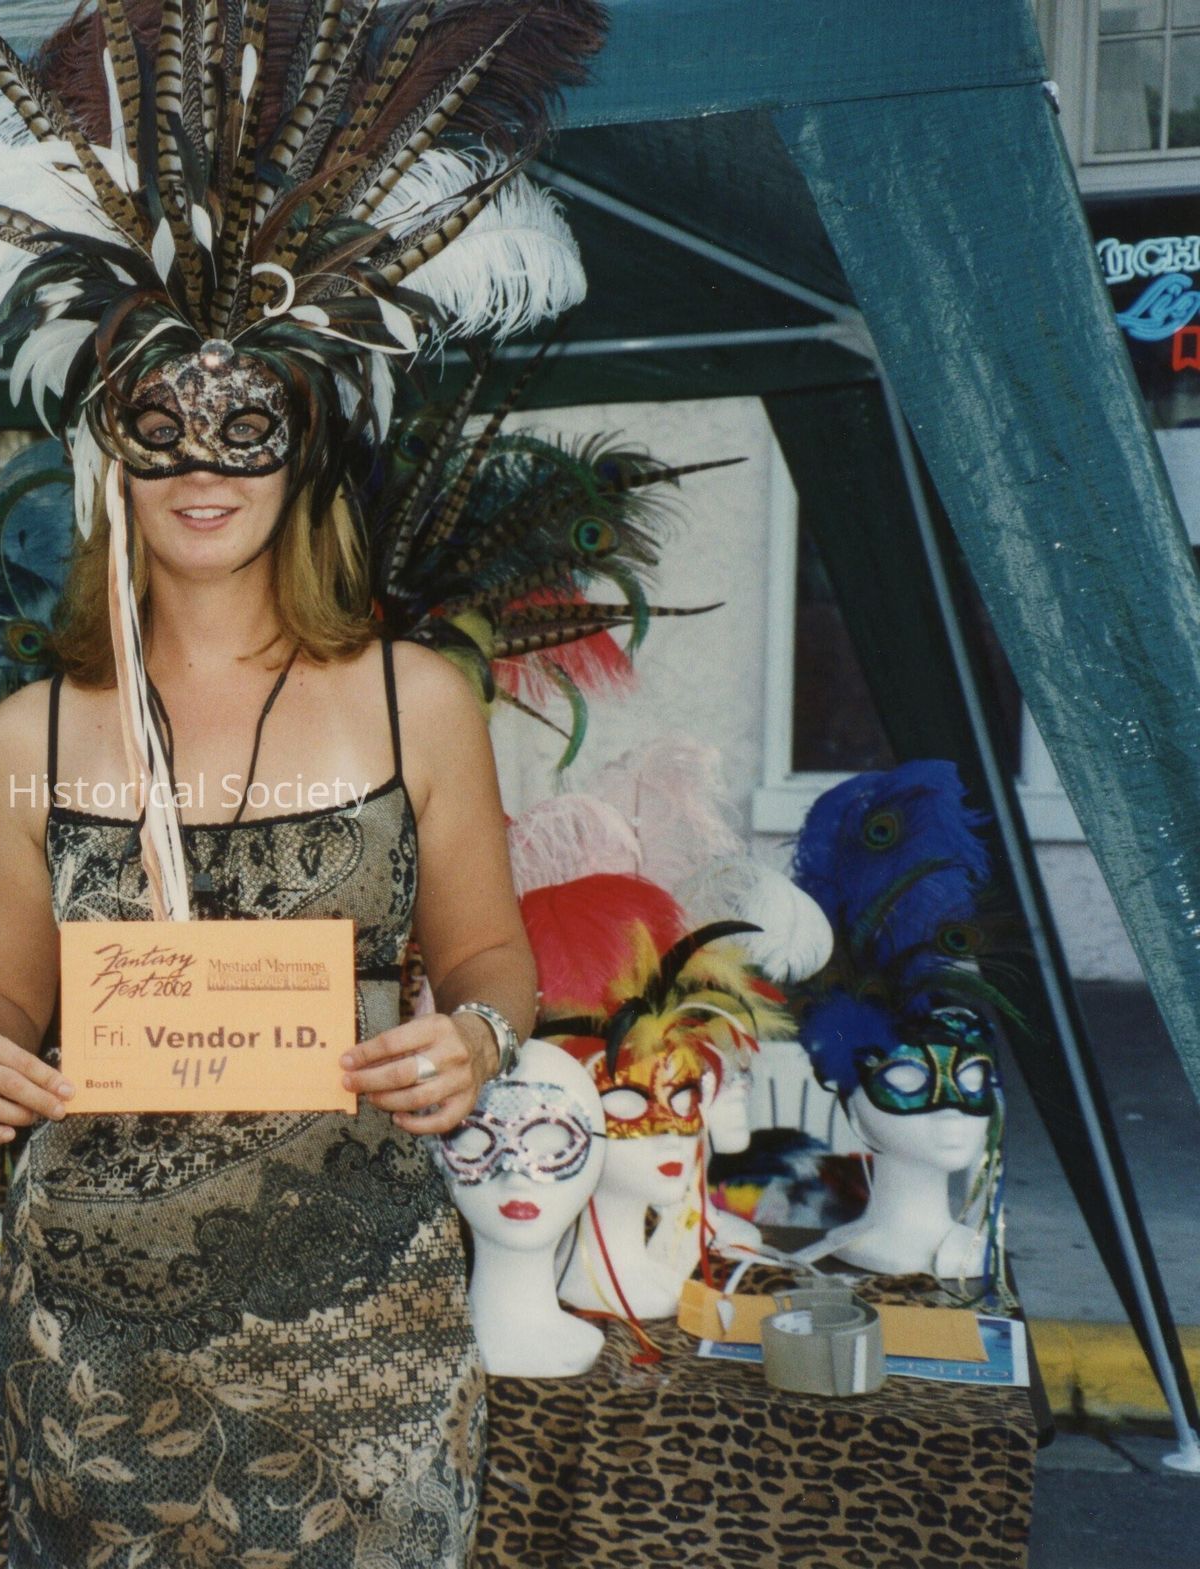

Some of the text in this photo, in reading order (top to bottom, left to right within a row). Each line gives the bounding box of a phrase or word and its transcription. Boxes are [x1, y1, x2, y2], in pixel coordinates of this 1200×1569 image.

[94, 944, 197, 972] Fantasy
[208, 958, 328, 975] Mystical Mornings
[90, 969, 193, 1014] Fest 2002
[93, 1025, 328, 1049] Fri. Vendor I.D.
[85, 1079, 123, 1090] Booth
[171, 1055, 229, 1088] 414
